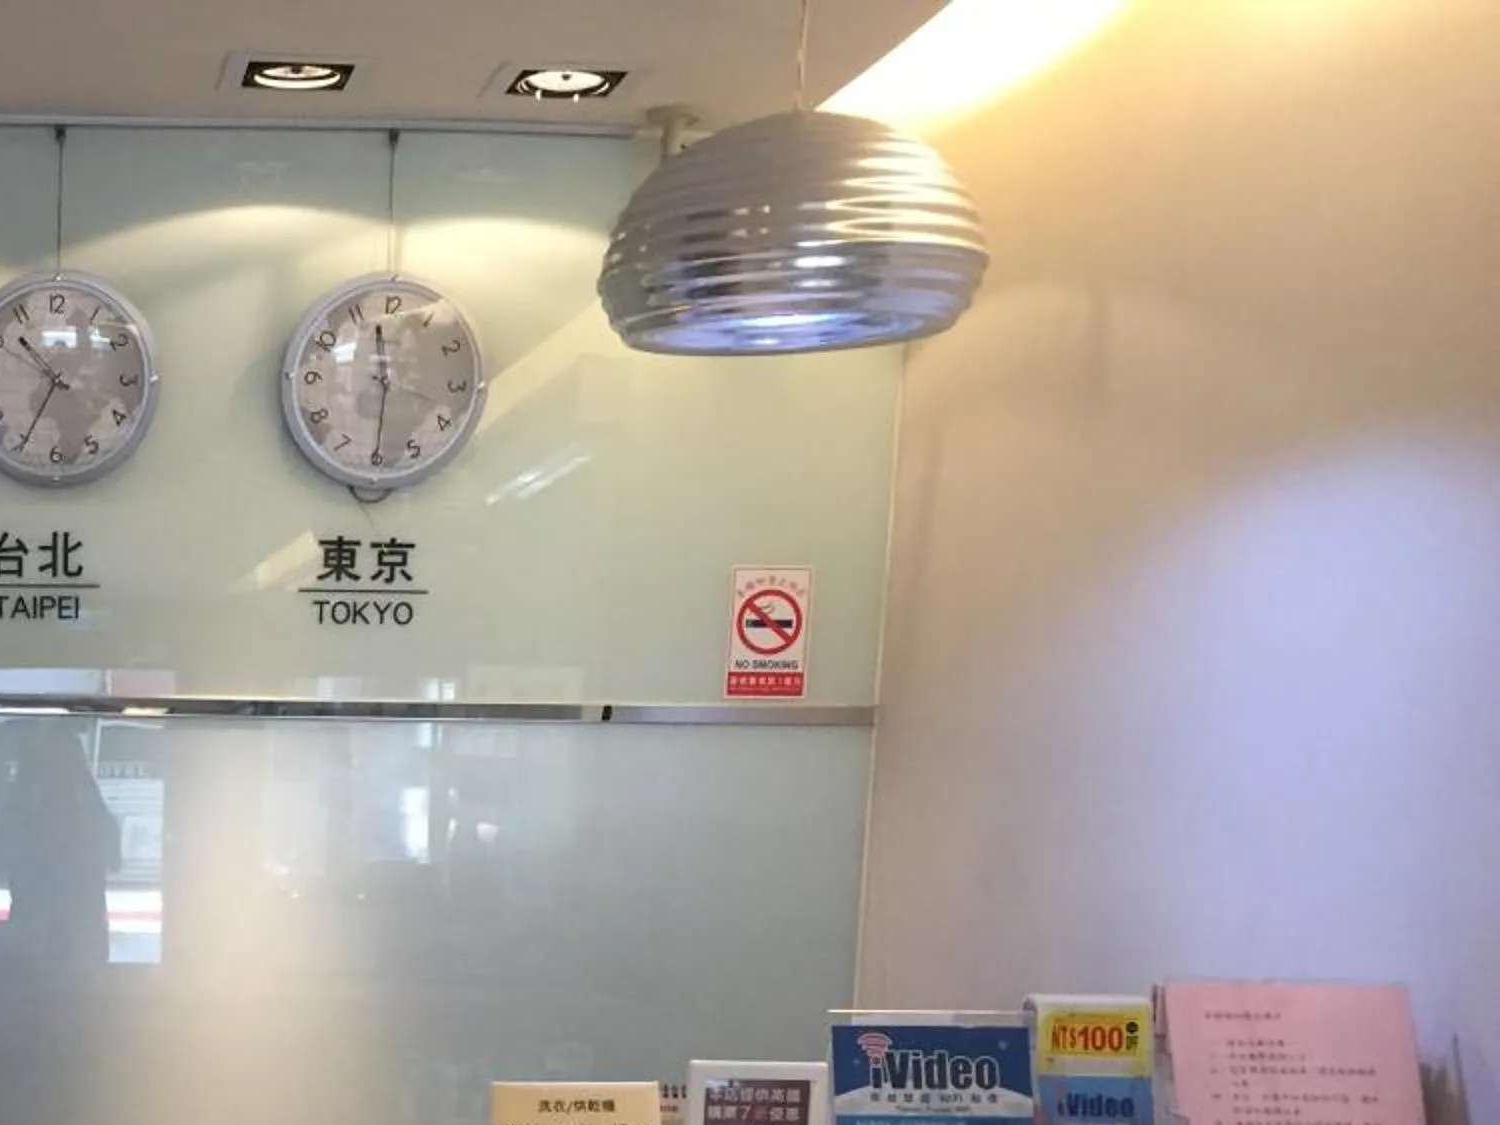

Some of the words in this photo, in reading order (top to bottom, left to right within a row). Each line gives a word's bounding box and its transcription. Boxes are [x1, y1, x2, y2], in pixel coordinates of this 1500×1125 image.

[50, 294, 65, 314] 12
[385, 296, 401, 314] 12
[13, 304, 30, 324] 11
[90, 307, 100, 323] 1
[349, 304, 364, 324] 11
[423, 312, 434, 327] 1
[109, 333, 128, 352] 2
[316, 330, 336, 352] 10
[441, 340, 460, 355] 2
[120, 374, 137, 387] 3
[304, 371, 322, 385] 9
[447, 380, 467, 393] 3
[112, 409, 126, 427] 4
[310, 409, 329, 424] 8
[437, 414, 453, 431] 4
[84, 434, 99, 454] 5
[334, 434, 352, 451] 7
[406, 439, 420, 459] 5
[50, 445, 63, 463] 6
[371, 449, 383, 466] 6
[316, 535, 416, 584] 東京
[313, 600, 414, 625] TOKYO
[735, 660, 750, 669] NO
[752, 660, 799, 669] SMOKING
[1052, 1024, 1124, 1051] NT$100
[871, 1050, 999, 1090] iVideo
